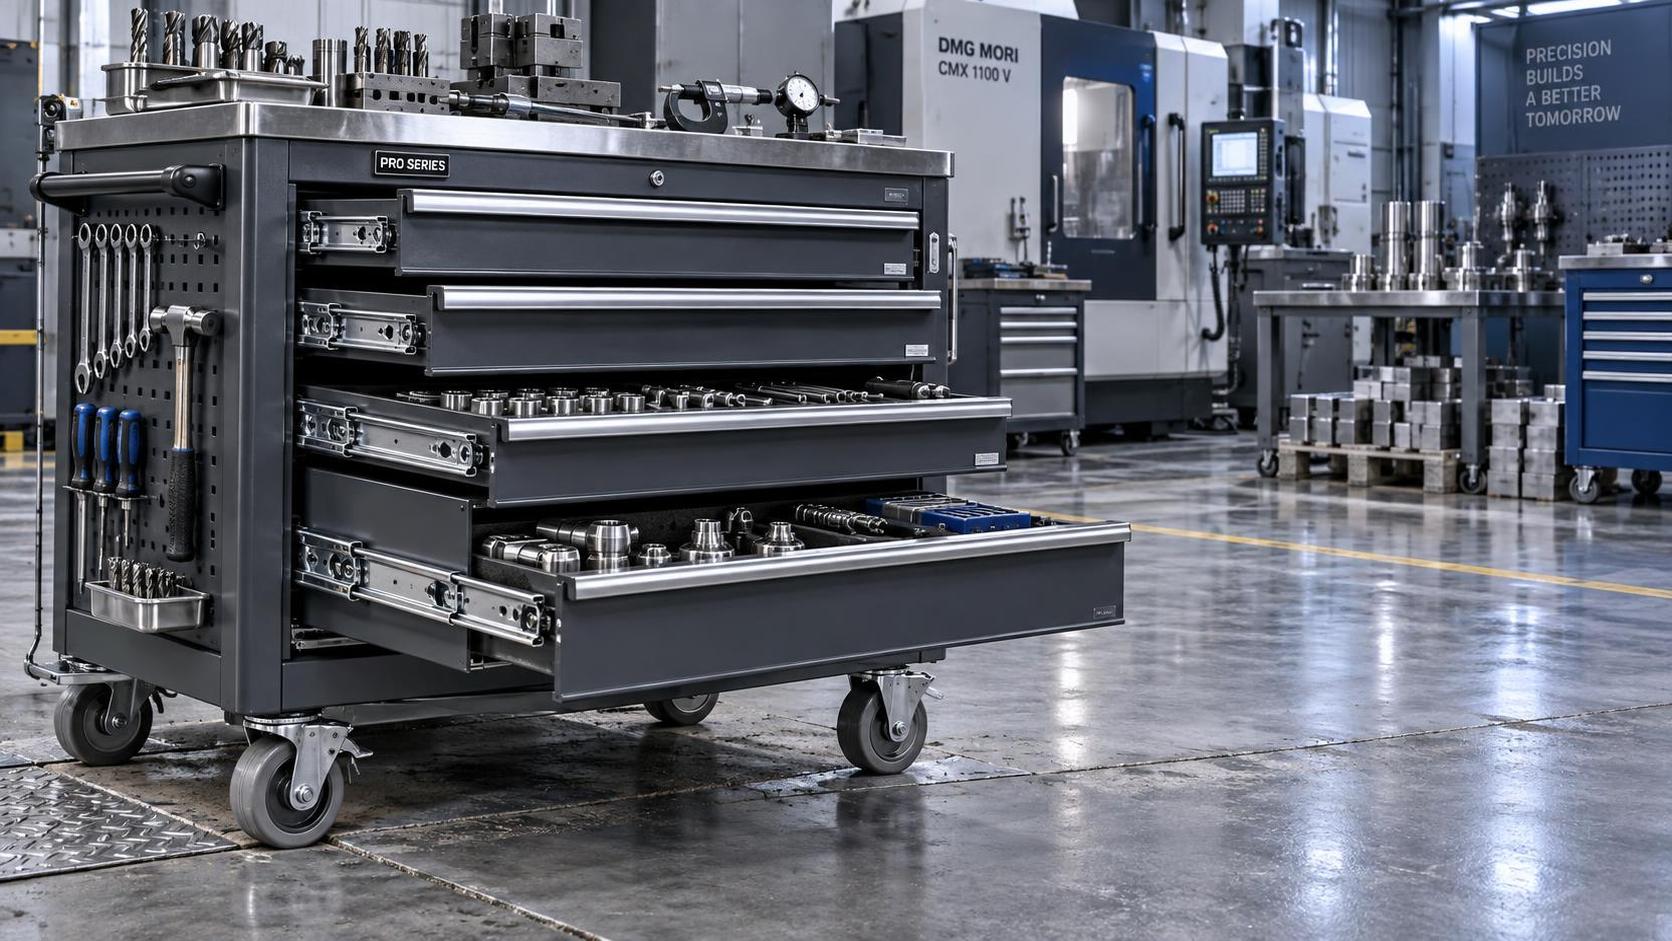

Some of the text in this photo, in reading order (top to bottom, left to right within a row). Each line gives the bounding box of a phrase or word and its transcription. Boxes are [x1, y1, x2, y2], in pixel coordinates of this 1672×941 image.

[939, 37, 1018, 63] DMG MORI
[1526, 39, 1611, 64] PRECISION
[939, 60, 1011, 83] CMX 1100 V
[1526, 64, 1583, 86] BUILDS
[1525, 85, 1601, 107] A BETTER
[1525, 105, 1621, 128] TOMORROW
[380, 157, 446, 171] PRO SERIES
